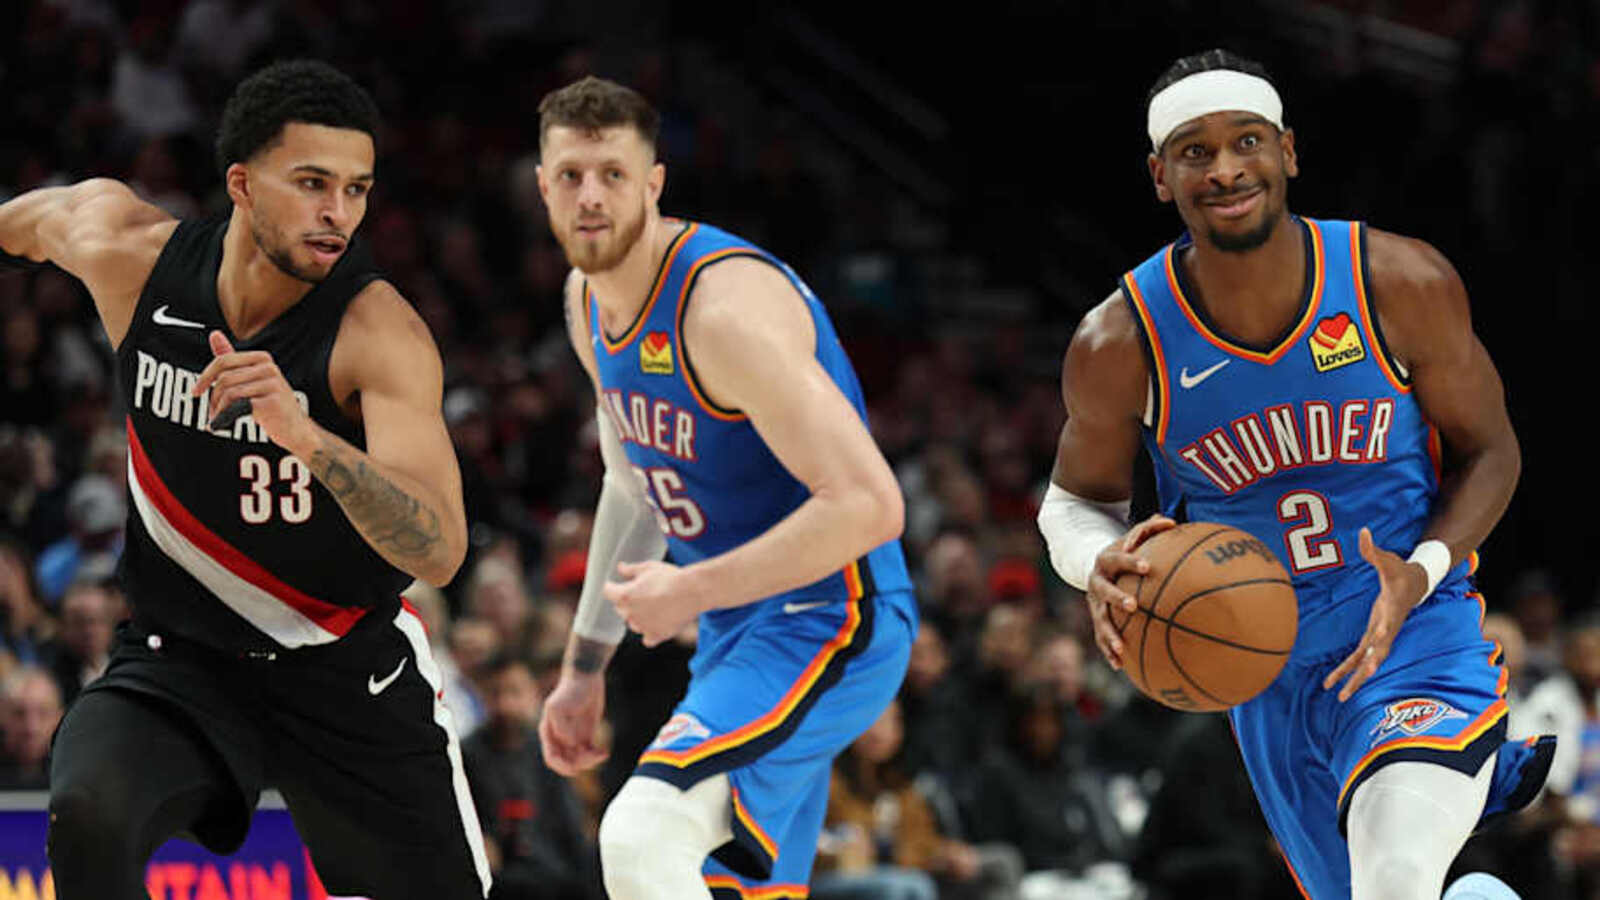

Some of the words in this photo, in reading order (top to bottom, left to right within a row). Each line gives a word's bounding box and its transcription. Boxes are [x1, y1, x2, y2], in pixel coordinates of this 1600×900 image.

[238, 453, 313, 525] 33
[1180, 398, 1395, 495] THUNDER
[1277, 489, 1344, 575] 2
